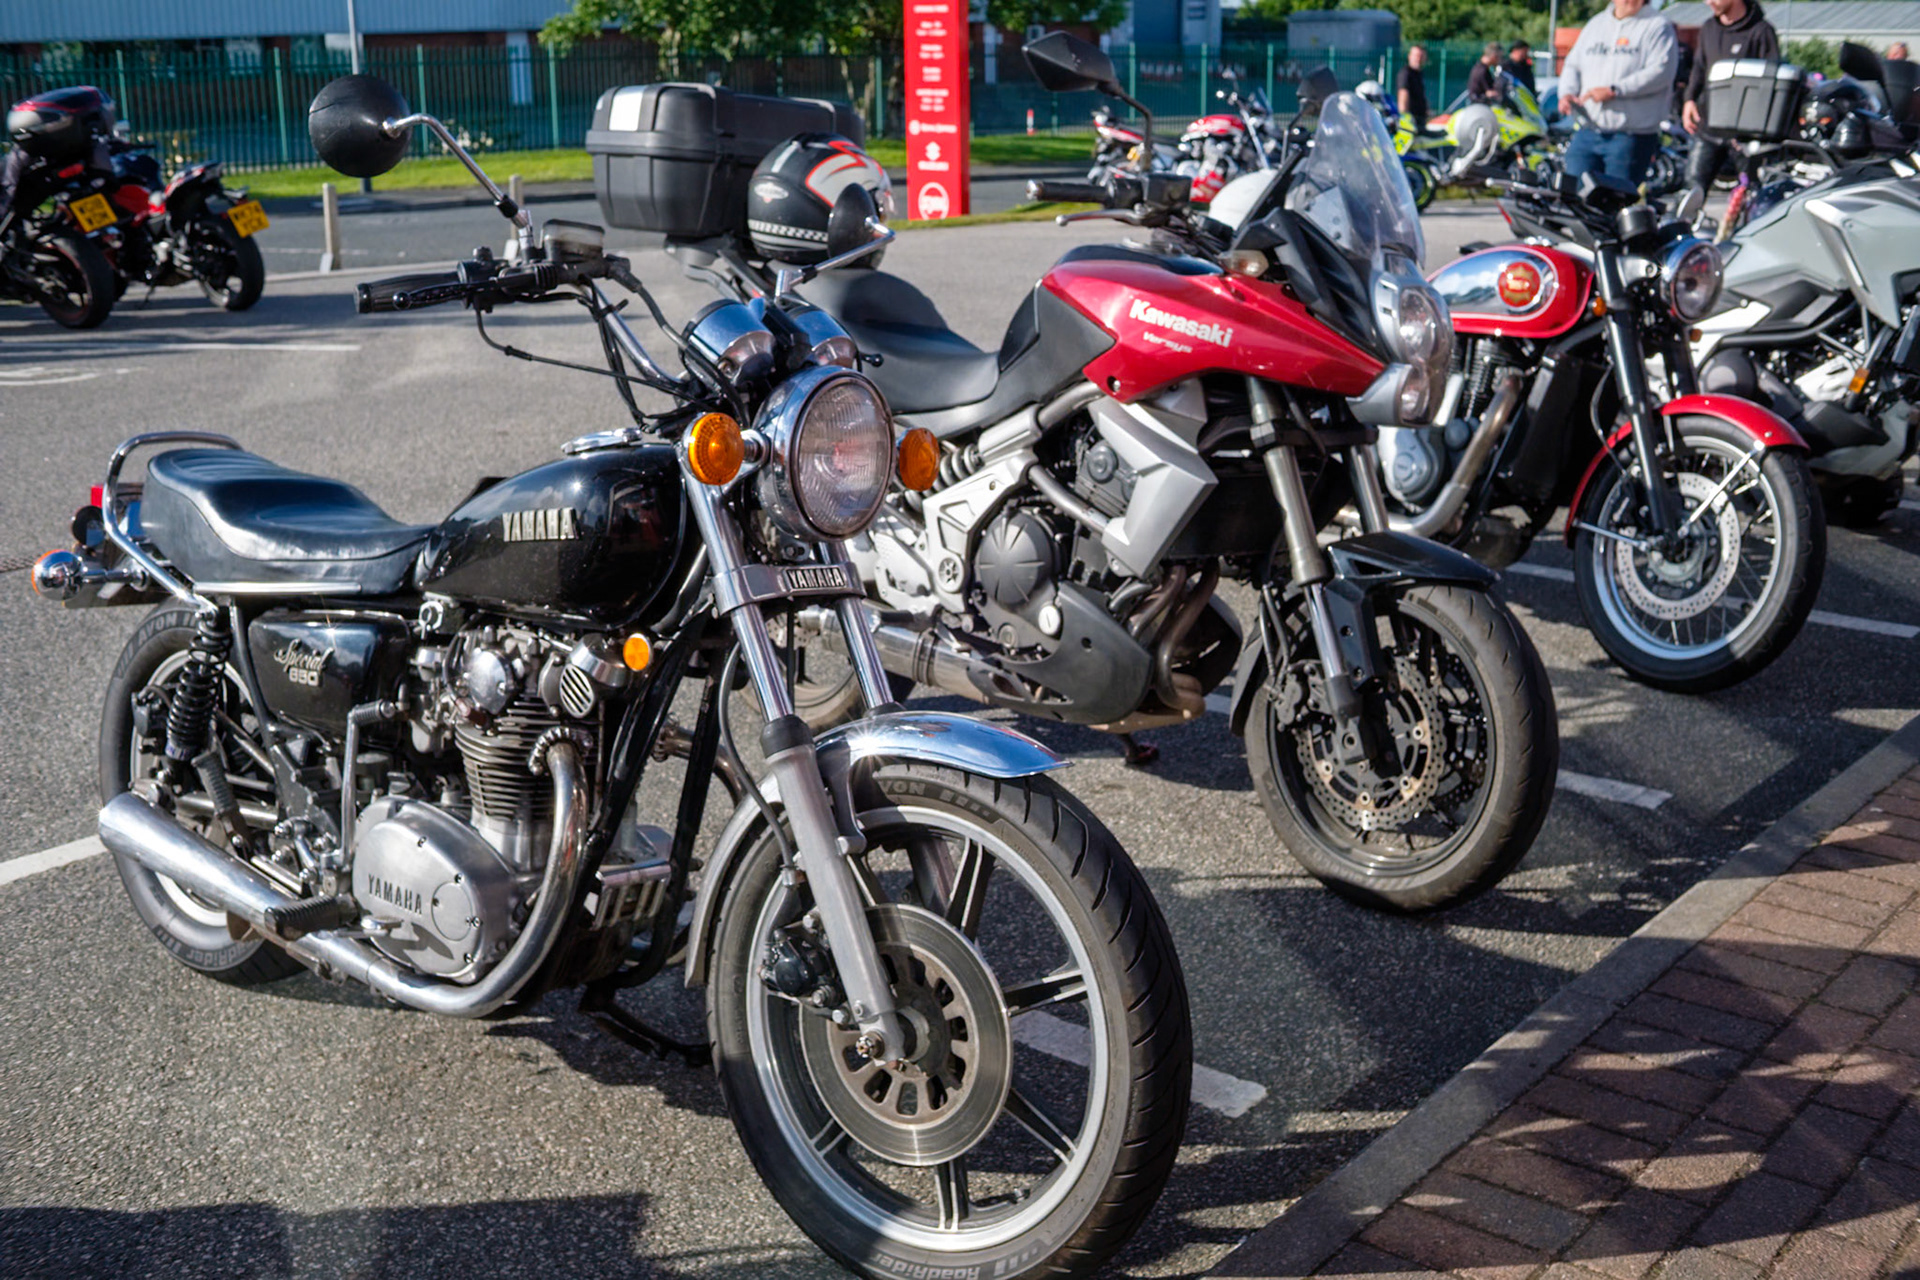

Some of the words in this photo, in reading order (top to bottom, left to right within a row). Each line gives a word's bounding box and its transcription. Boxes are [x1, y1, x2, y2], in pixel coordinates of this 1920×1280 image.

[1129, 299, 1233, 347] Kawasaki
[502, 507, 575, 542] YAMAHA
[788, 568, 844, 588] YAMAHA
[139, 611, 178, 646] AVON
[273, 638, 334, 672] Special
[289, 667, 319, 687] 650
[878, 780, 926, 796] VON
[368, 873, 422, 915] YAMAHA
